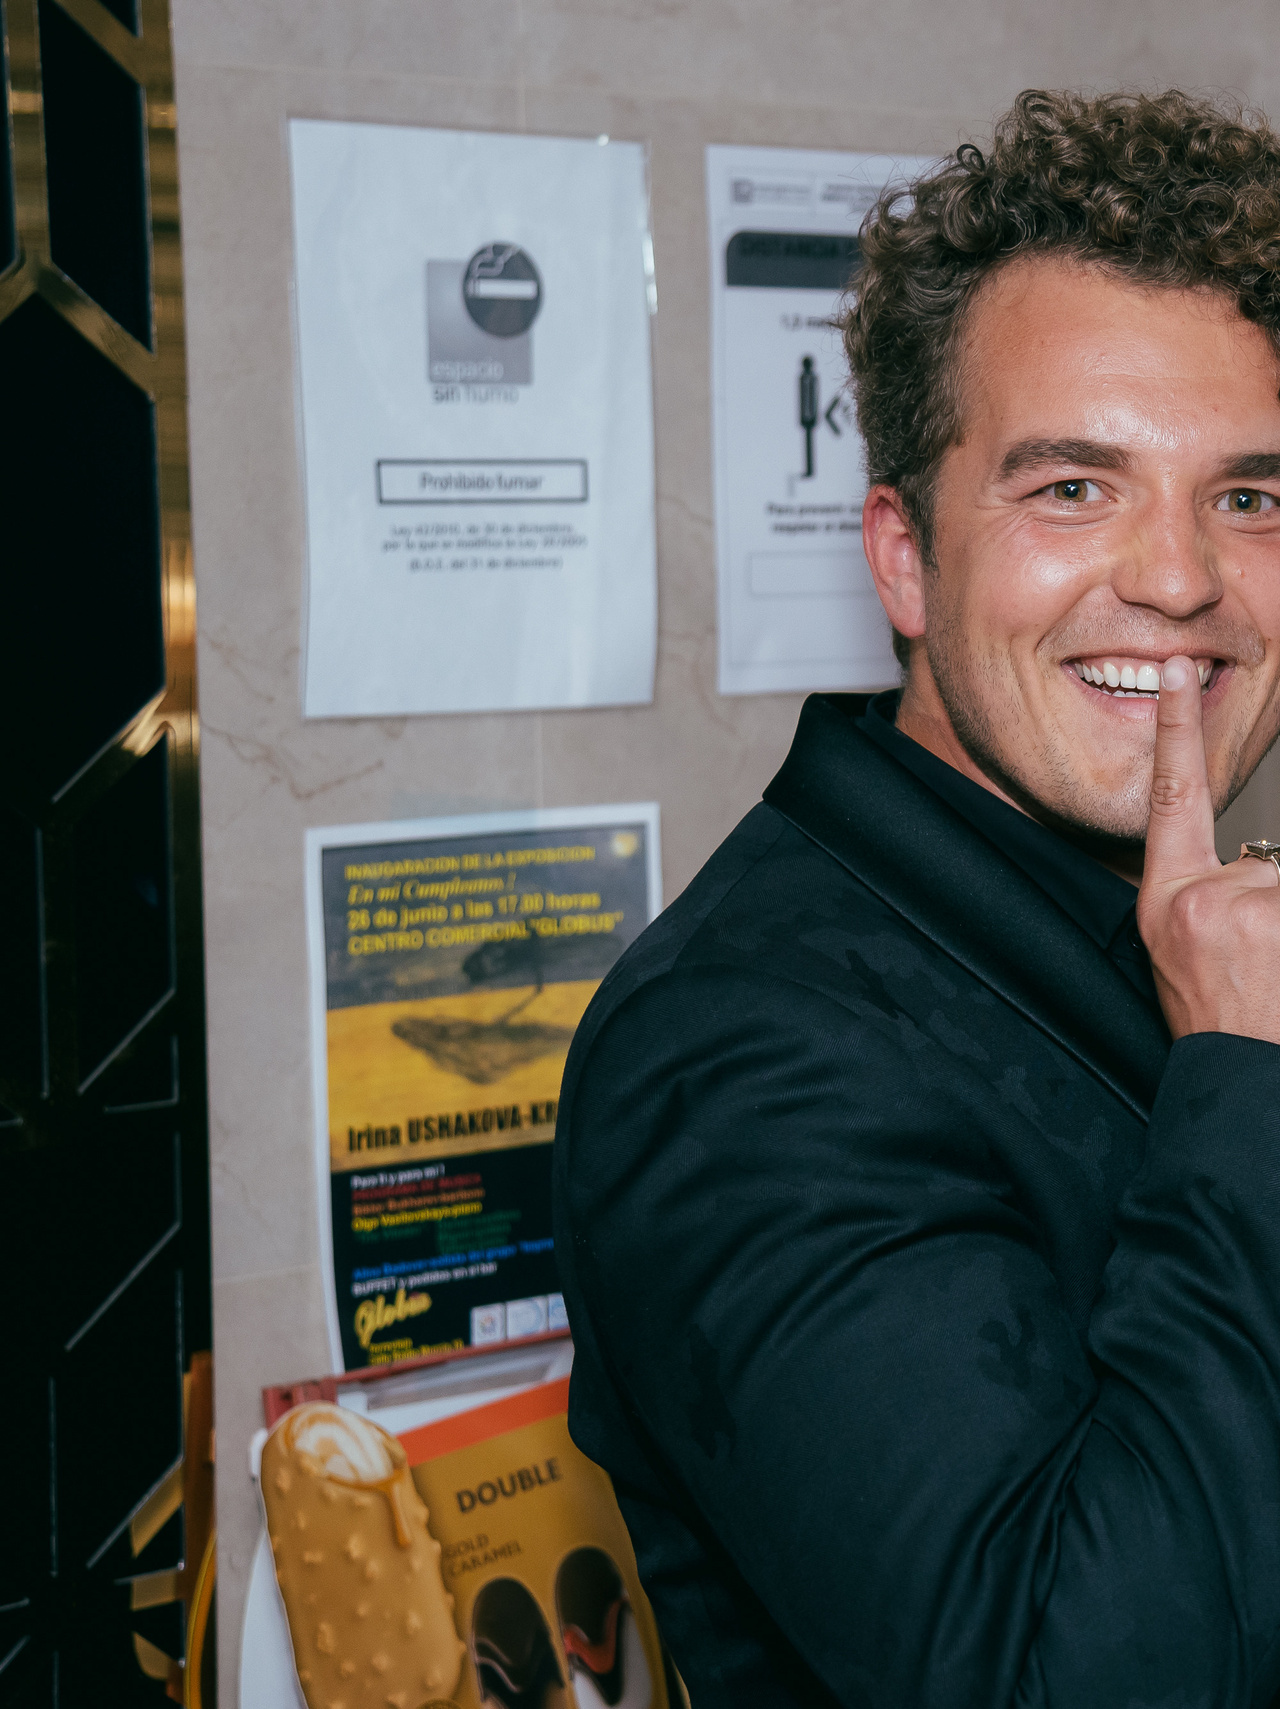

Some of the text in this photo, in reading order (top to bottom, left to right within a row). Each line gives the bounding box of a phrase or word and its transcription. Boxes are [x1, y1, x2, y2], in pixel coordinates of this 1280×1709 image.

[431, 361, 503, 384] espacio
[432, 383, 460, 404] sin
[419, 471, 544, 493] Prohibido fumar
[461, 853, 480, 871] DE
[481, 852, 504, 870] LA
[505, 846, 596, 868] EXPOSICION
[347, 884, 374, 906] En
[376, 881, 402, 903] mi
[372, 905, 398, 930] de
[400, 901, 449, 931] junio
[450, 903, 464, 921] a
[465, 898, 494, 920] las
[545, 891, 602, 913] horas
[347, 928, 424, 956] CENTRO
[425, 920, 530, 950] COMERCIAL
[348, 1123, 403, 1154] Irina
[456, 1457, 563, 1515] DOUBLE
[446, 1540, 524, 1578] CARAMEL
